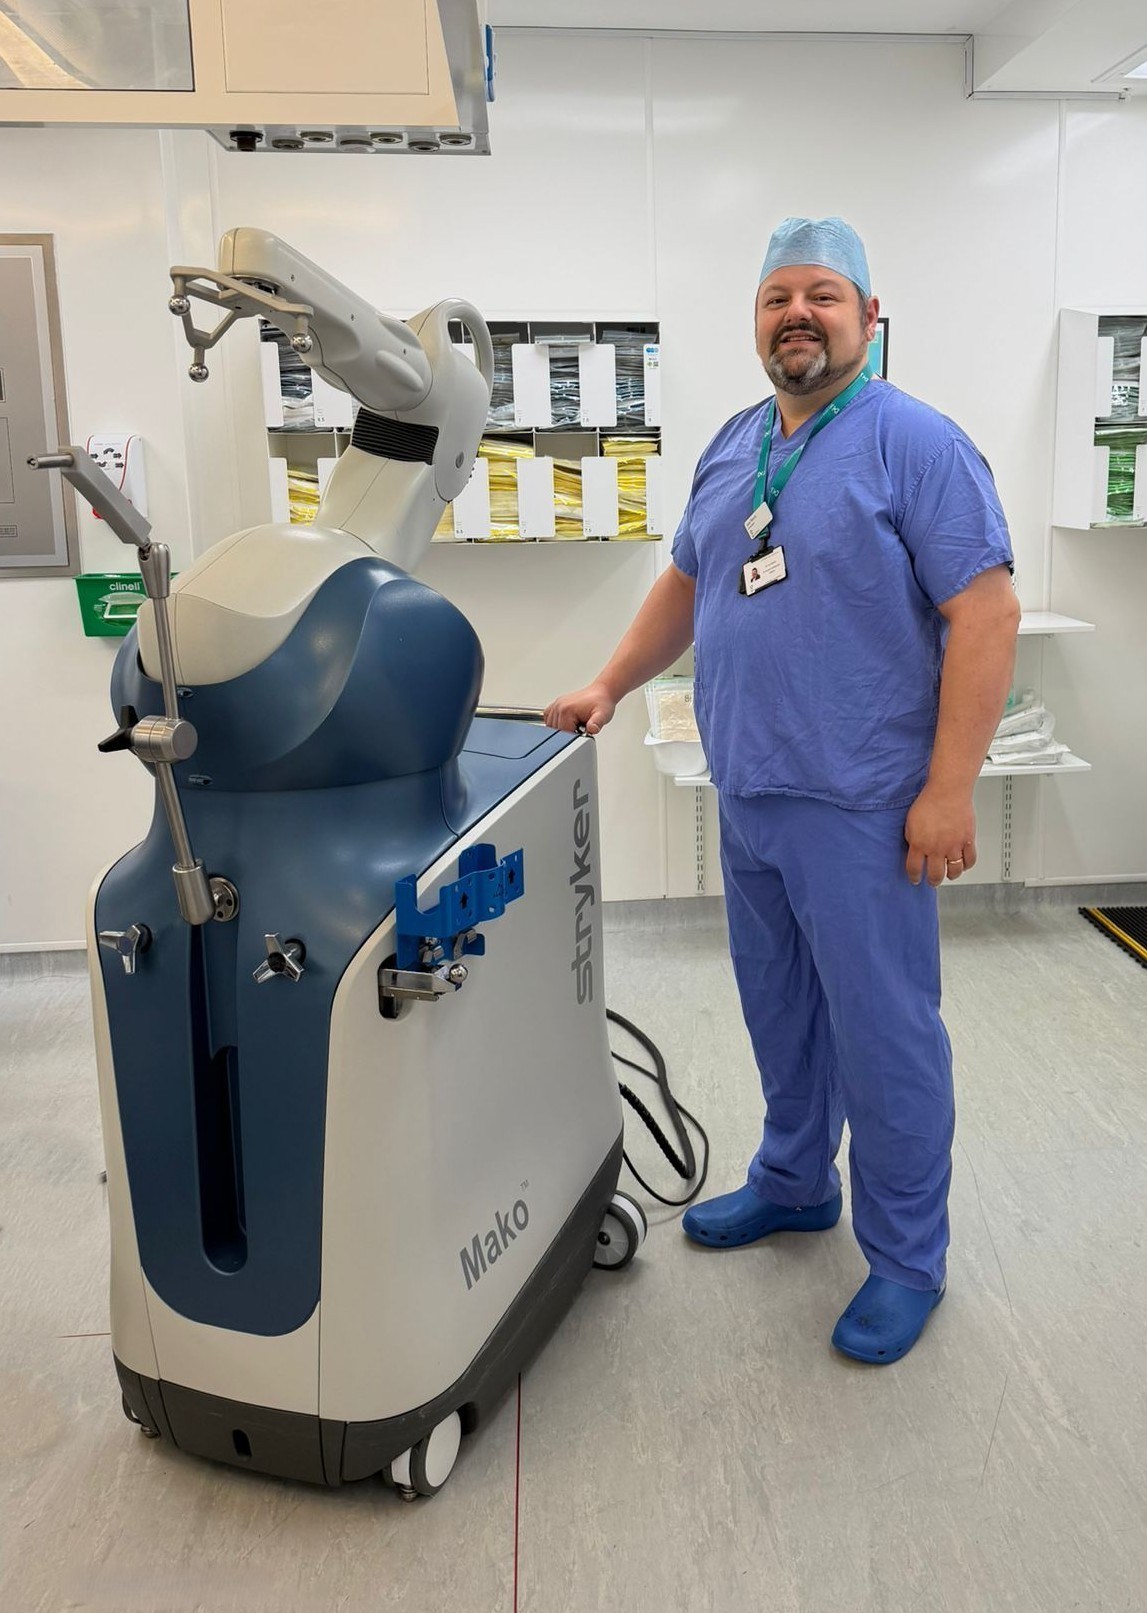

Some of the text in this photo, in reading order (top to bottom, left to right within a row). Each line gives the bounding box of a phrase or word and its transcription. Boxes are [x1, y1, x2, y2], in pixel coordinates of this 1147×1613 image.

[109, 581, 140, 591] clinell
[569, 778, 596, 1006] stryker
[459, 1199, 530, 1291] Mako
